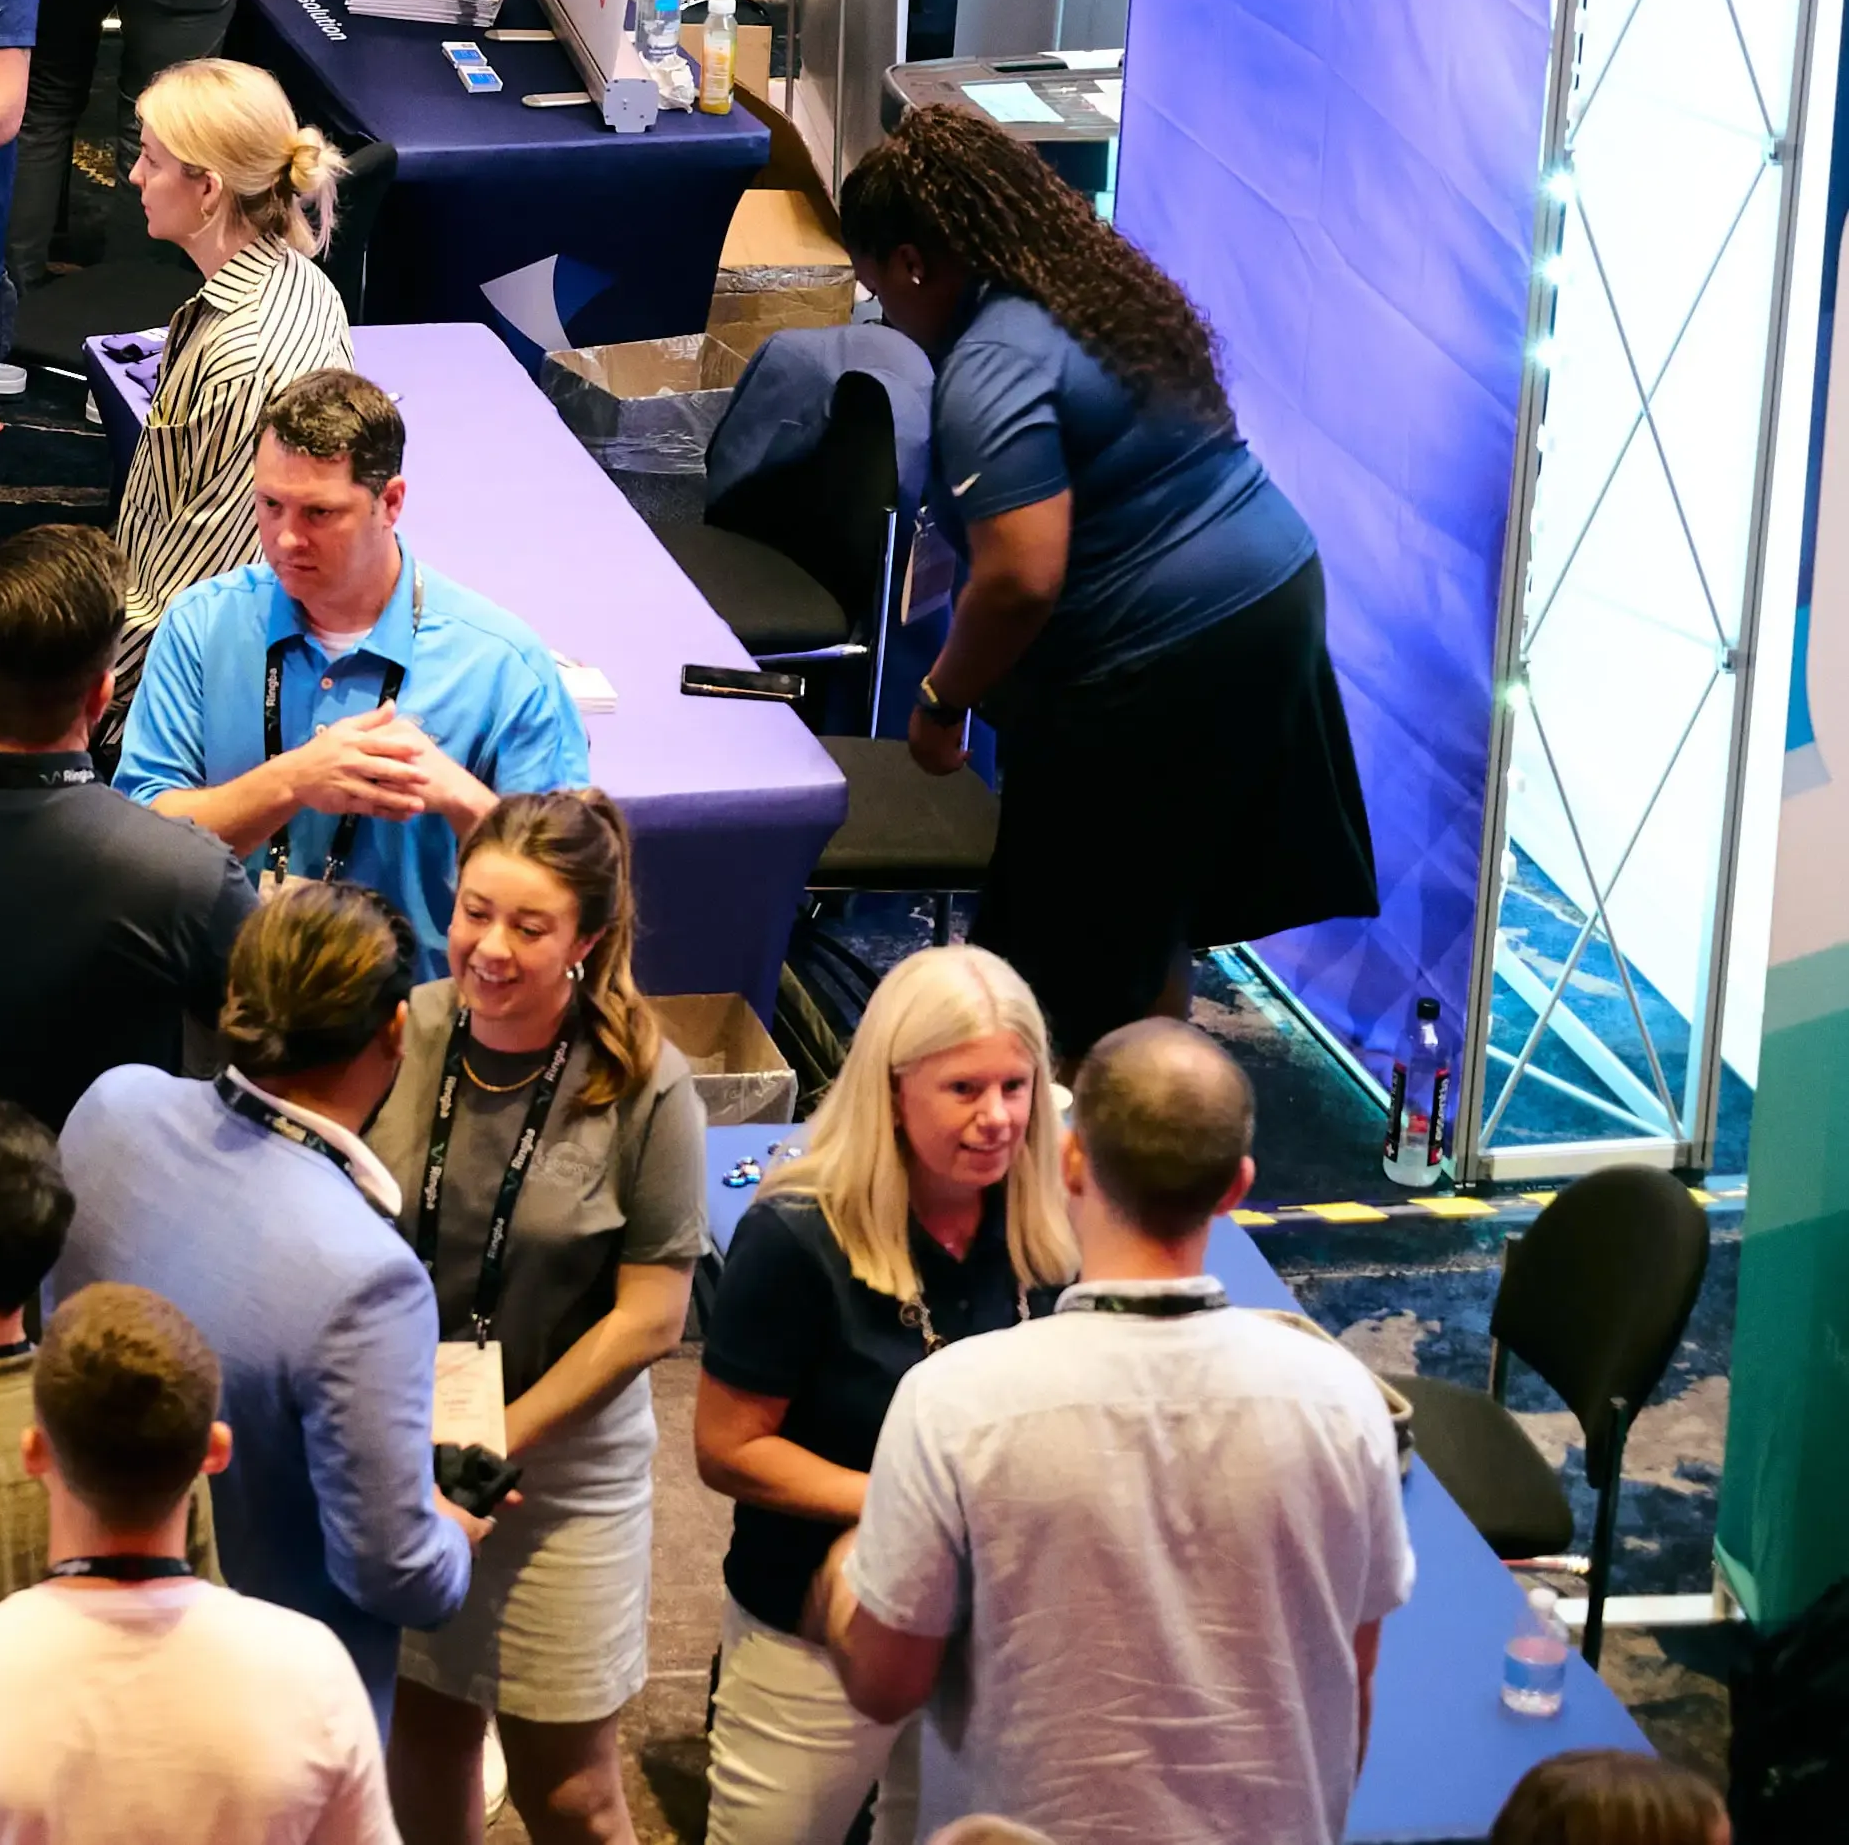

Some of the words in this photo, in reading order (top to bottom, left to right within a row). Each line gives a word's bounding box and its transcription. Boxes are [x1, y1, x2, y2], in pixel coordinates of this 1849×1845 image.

[267, 667, 279, 707] Ringba
[64, 768, 95, 783] Ringba
[545, 1041, 568, 1081] Ringba
[440, 1075, 457, 1118] Ringba
[511, 1128, 535, 1170] Ringba
[425, 1165, 442, 1210] Ringba
